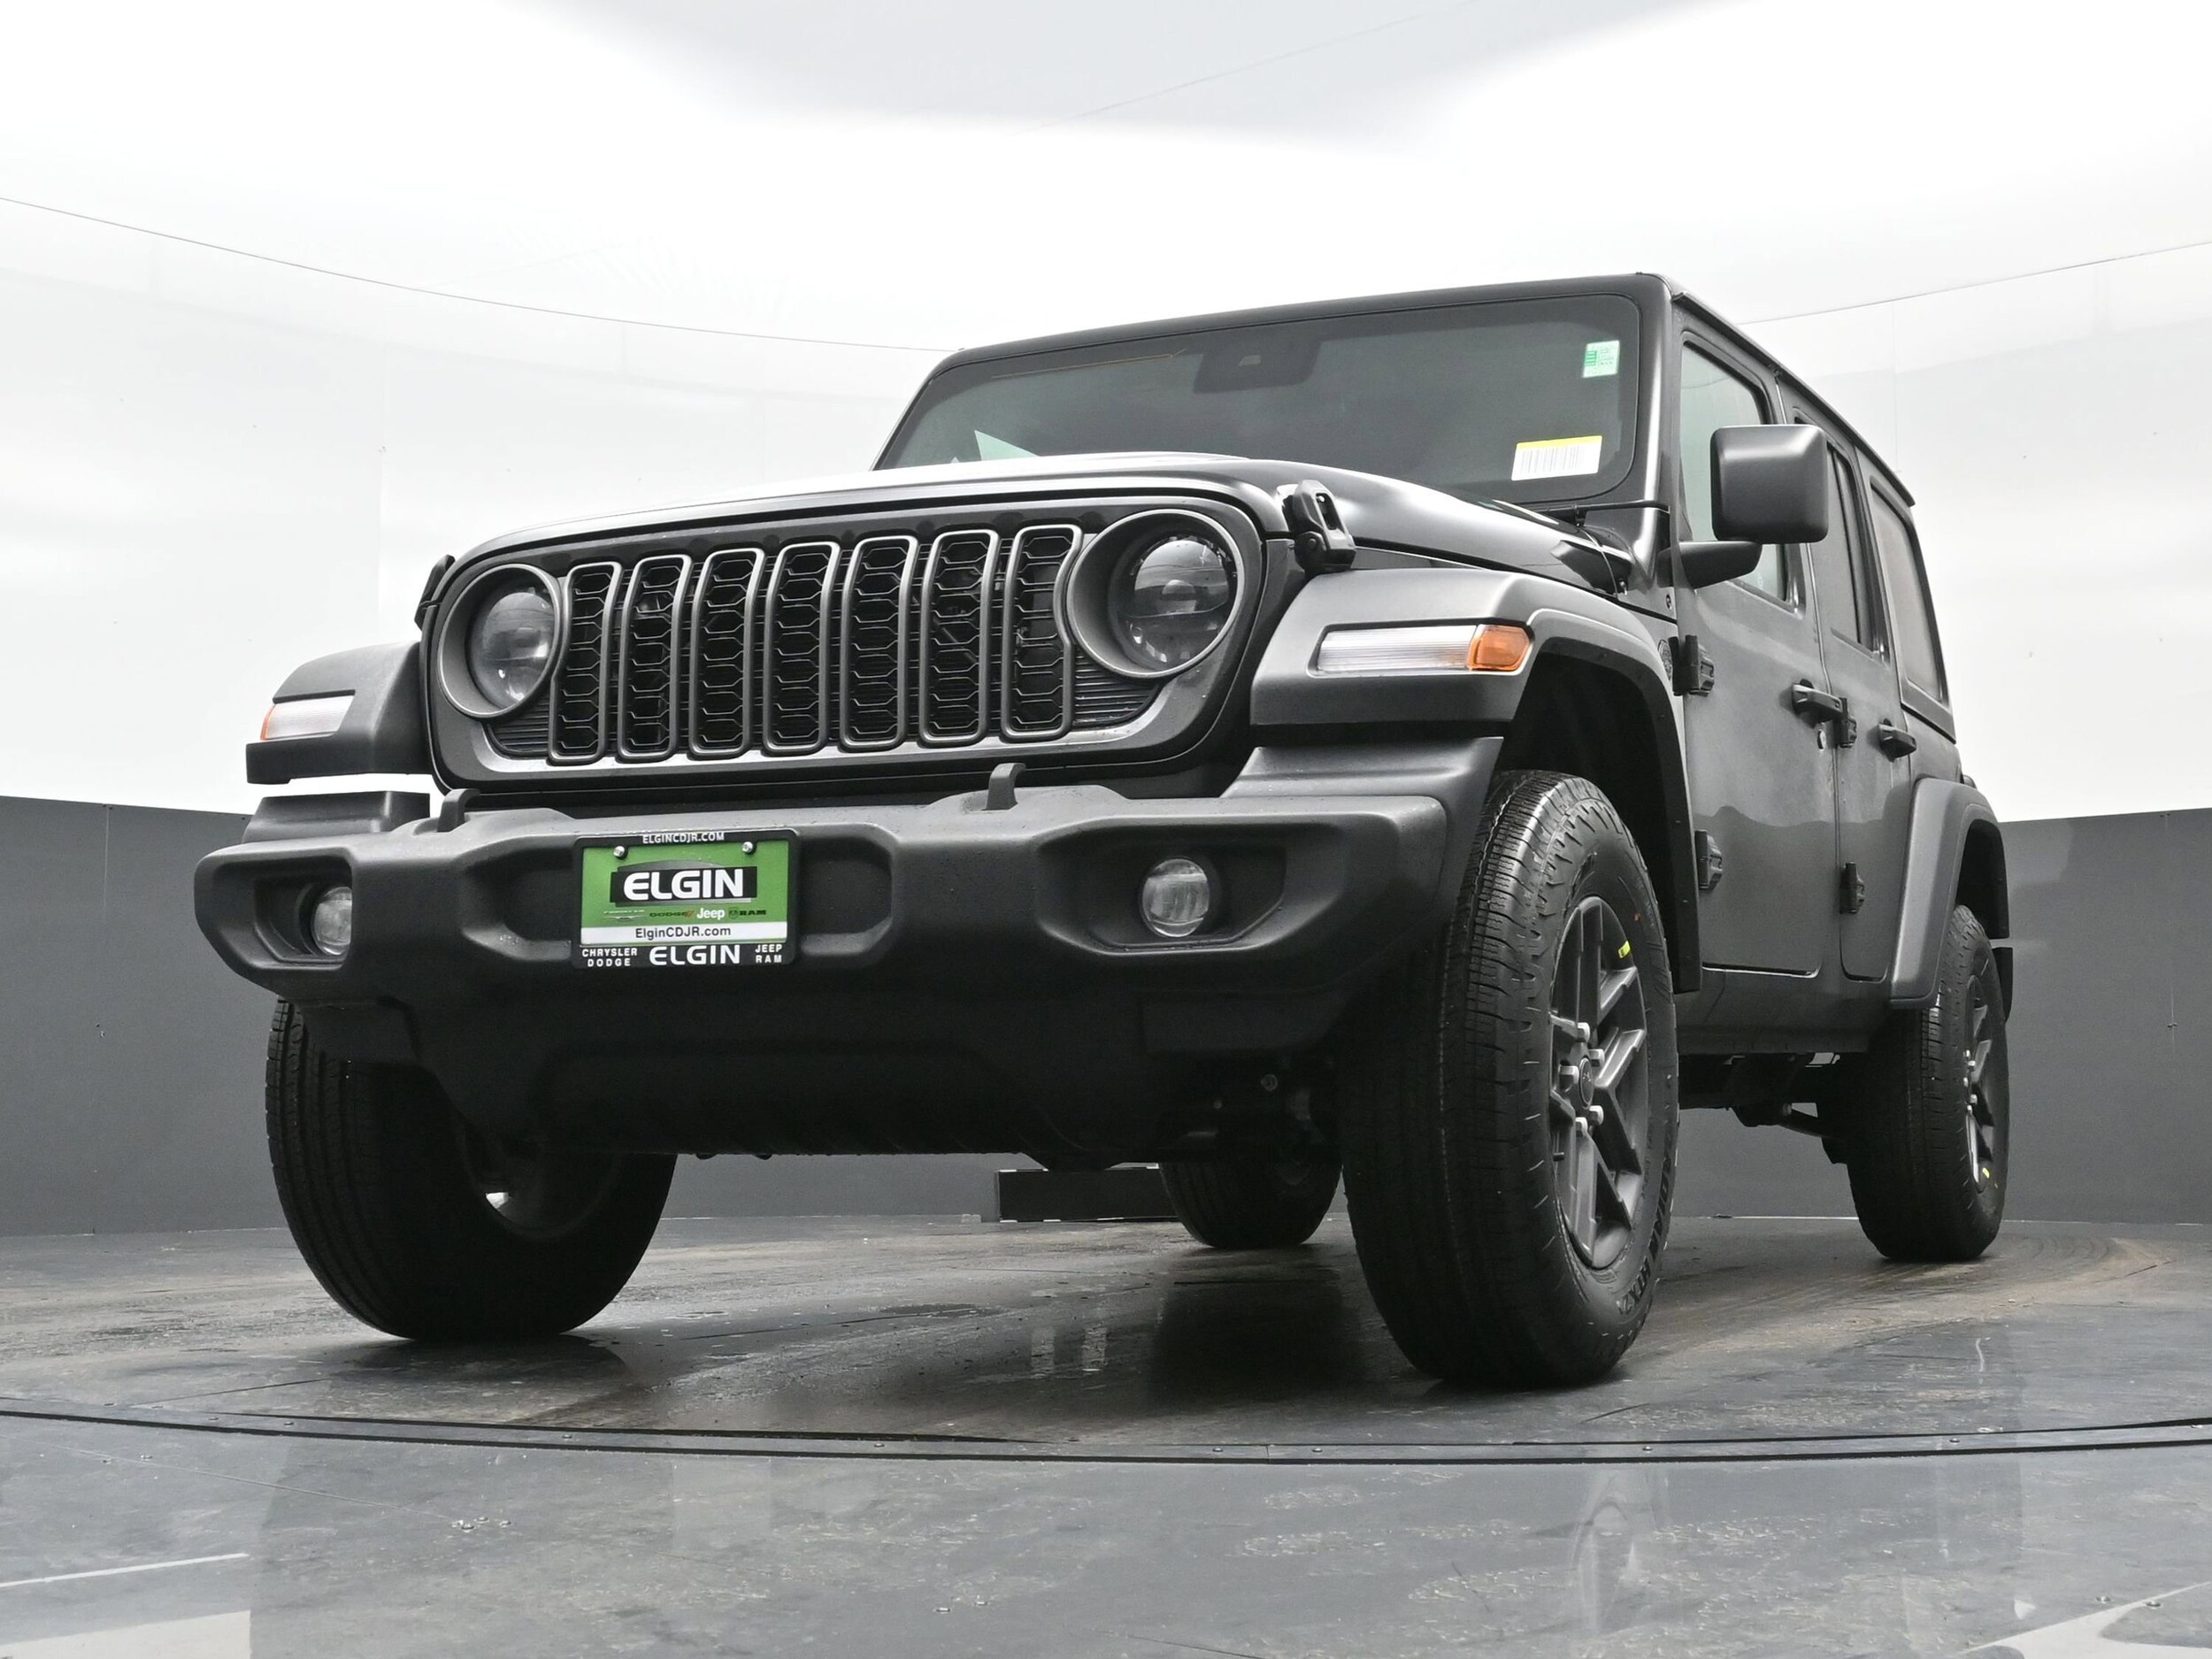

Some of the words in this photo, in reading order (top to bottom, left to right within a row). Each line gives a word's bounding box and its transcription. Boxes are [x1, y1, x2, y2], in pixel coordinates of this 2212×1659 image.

[642, 833, 725, 844] ELGINCDJR.COM
[623, 869, 743, 901] ELGIN
[696, 908, 726, 919] Jeep
[635, 926, 731, 940] ElginCDJR.com
[581, 948, 637, 958] CHRYSLER
[755, 944, 782, 953] JEEP
[649, 944, 741, 965] ELGIN
[755, 955, 782, 964] RAM
[587, 958, 630, 967] DODGE
